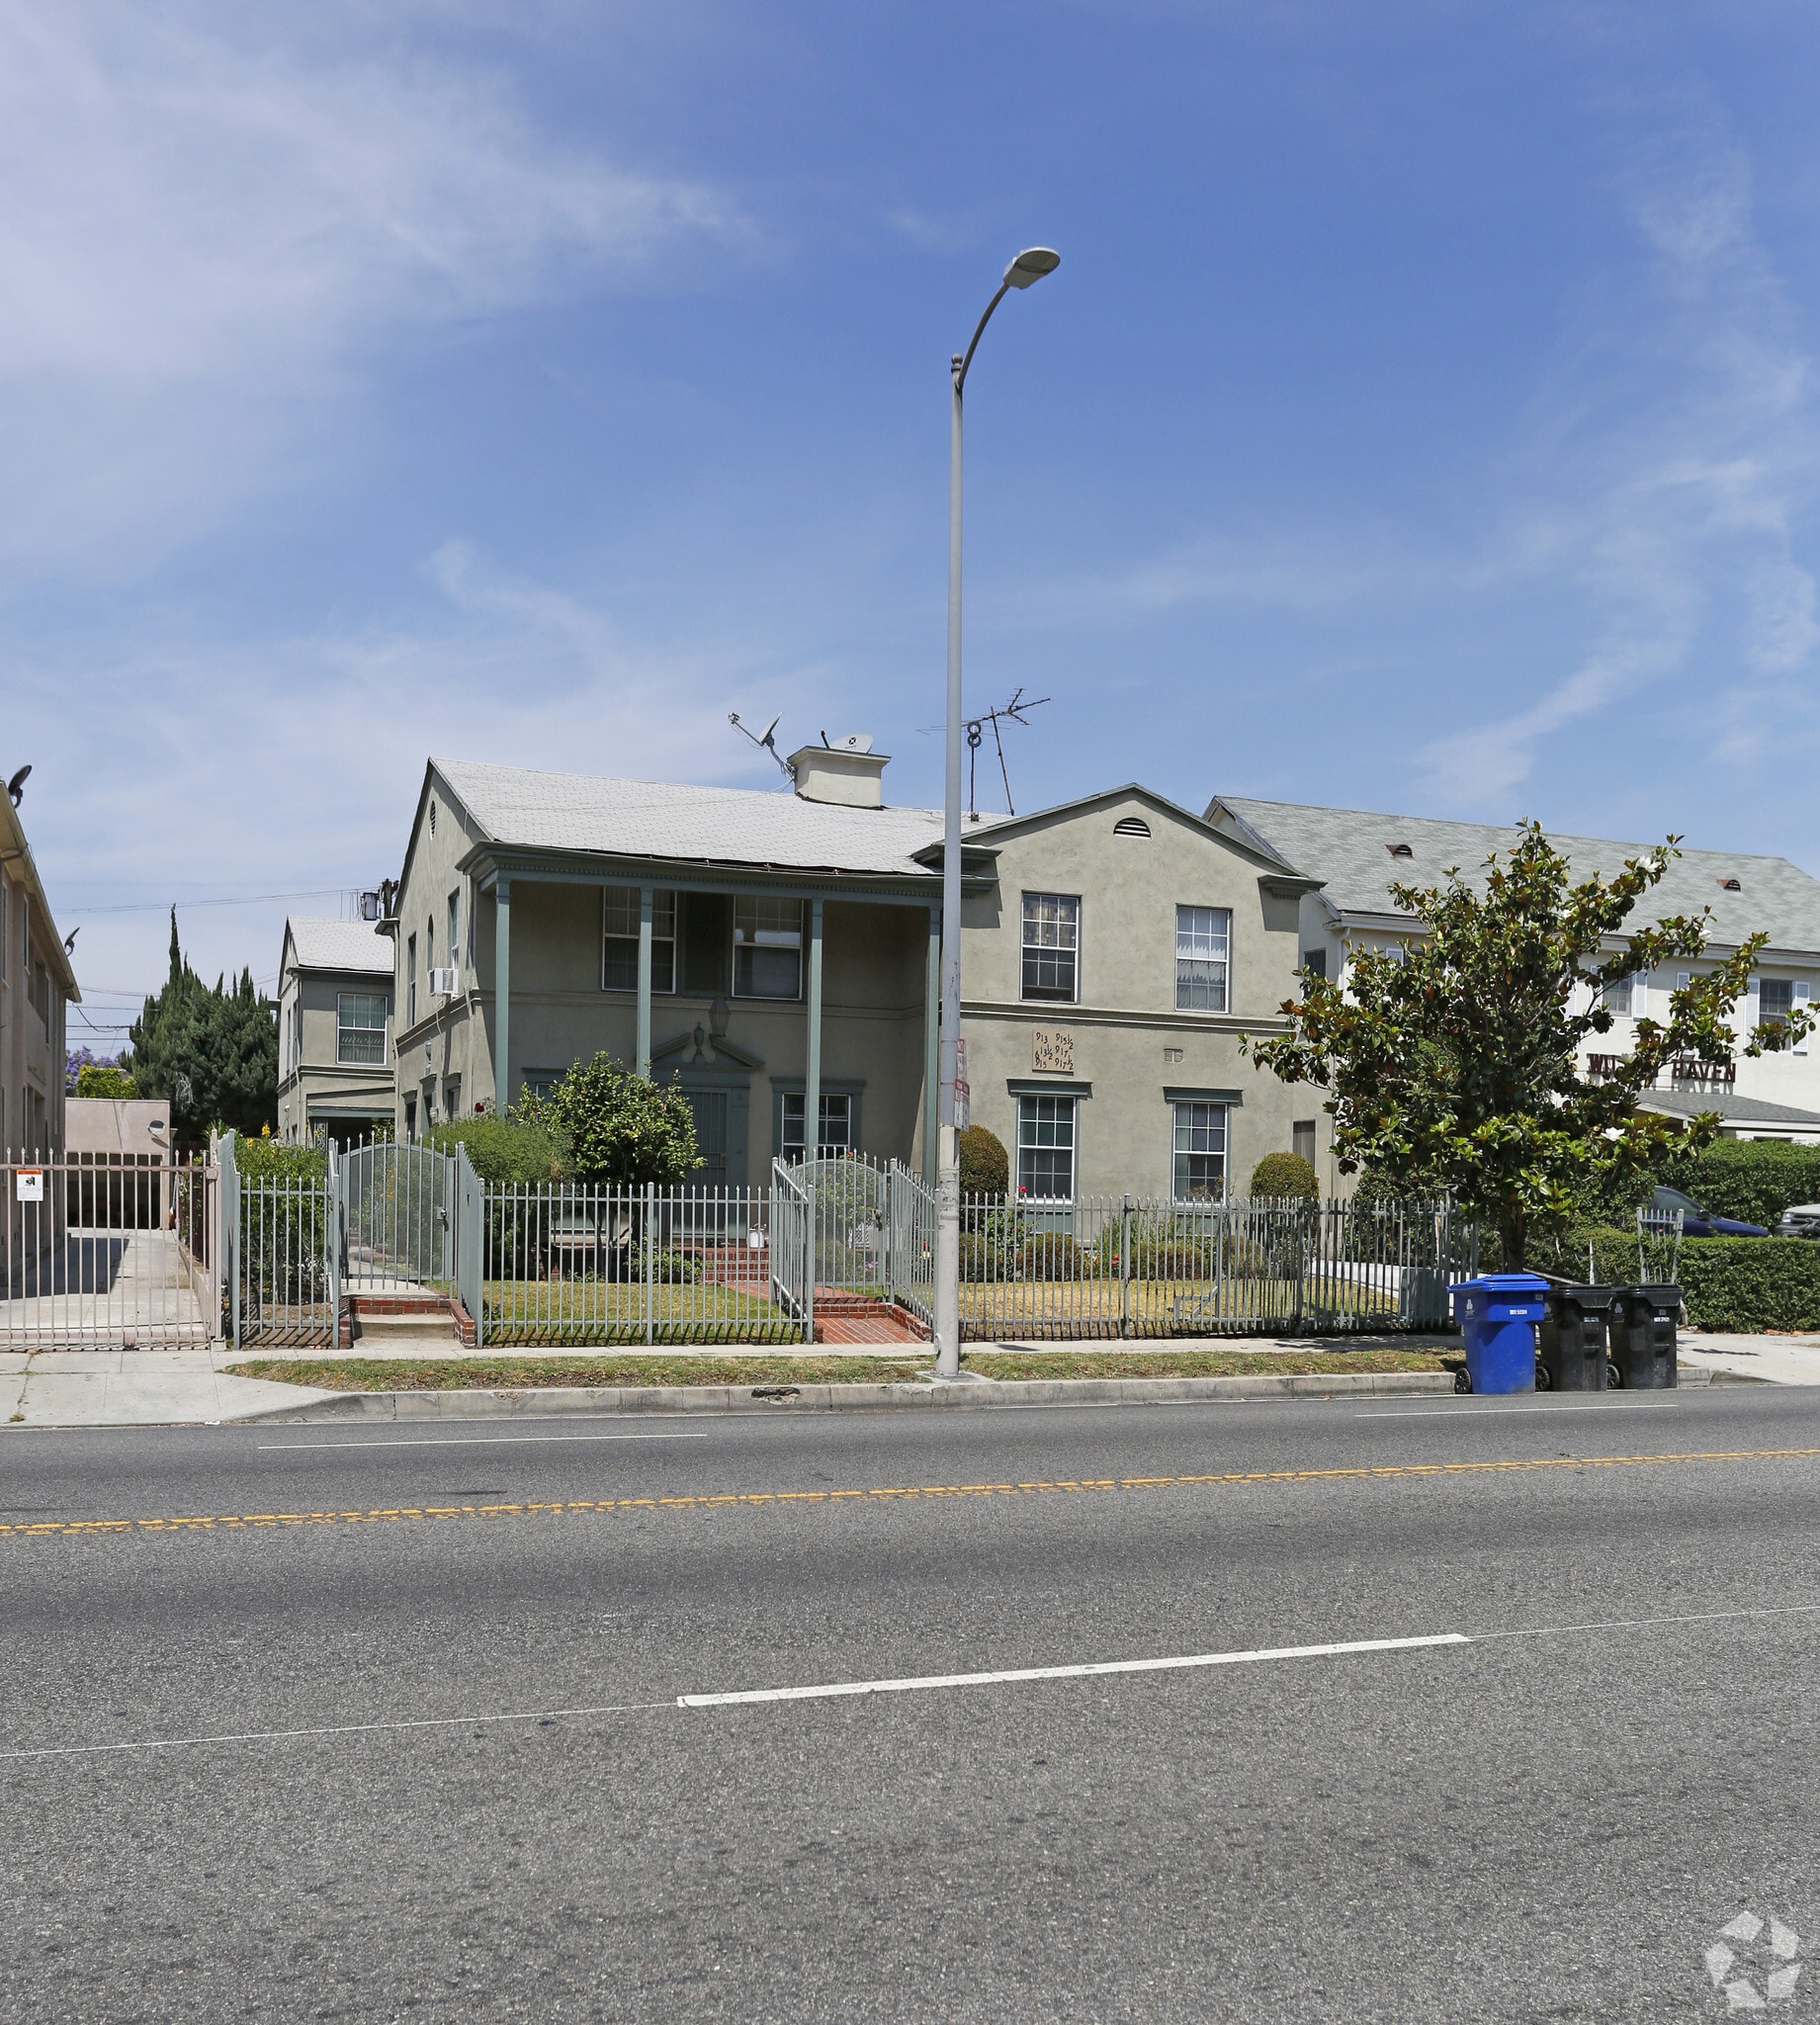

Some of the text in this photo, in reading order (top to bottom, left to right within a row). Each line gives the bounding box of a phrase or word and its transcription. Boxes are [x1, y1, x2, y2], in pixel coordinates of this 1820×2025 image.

[1036, 1031, 1048, 1044] 913
[1055, 1045, 1069, 1058] 917
[1671, 1059, 1736, 1083] HAVEN
